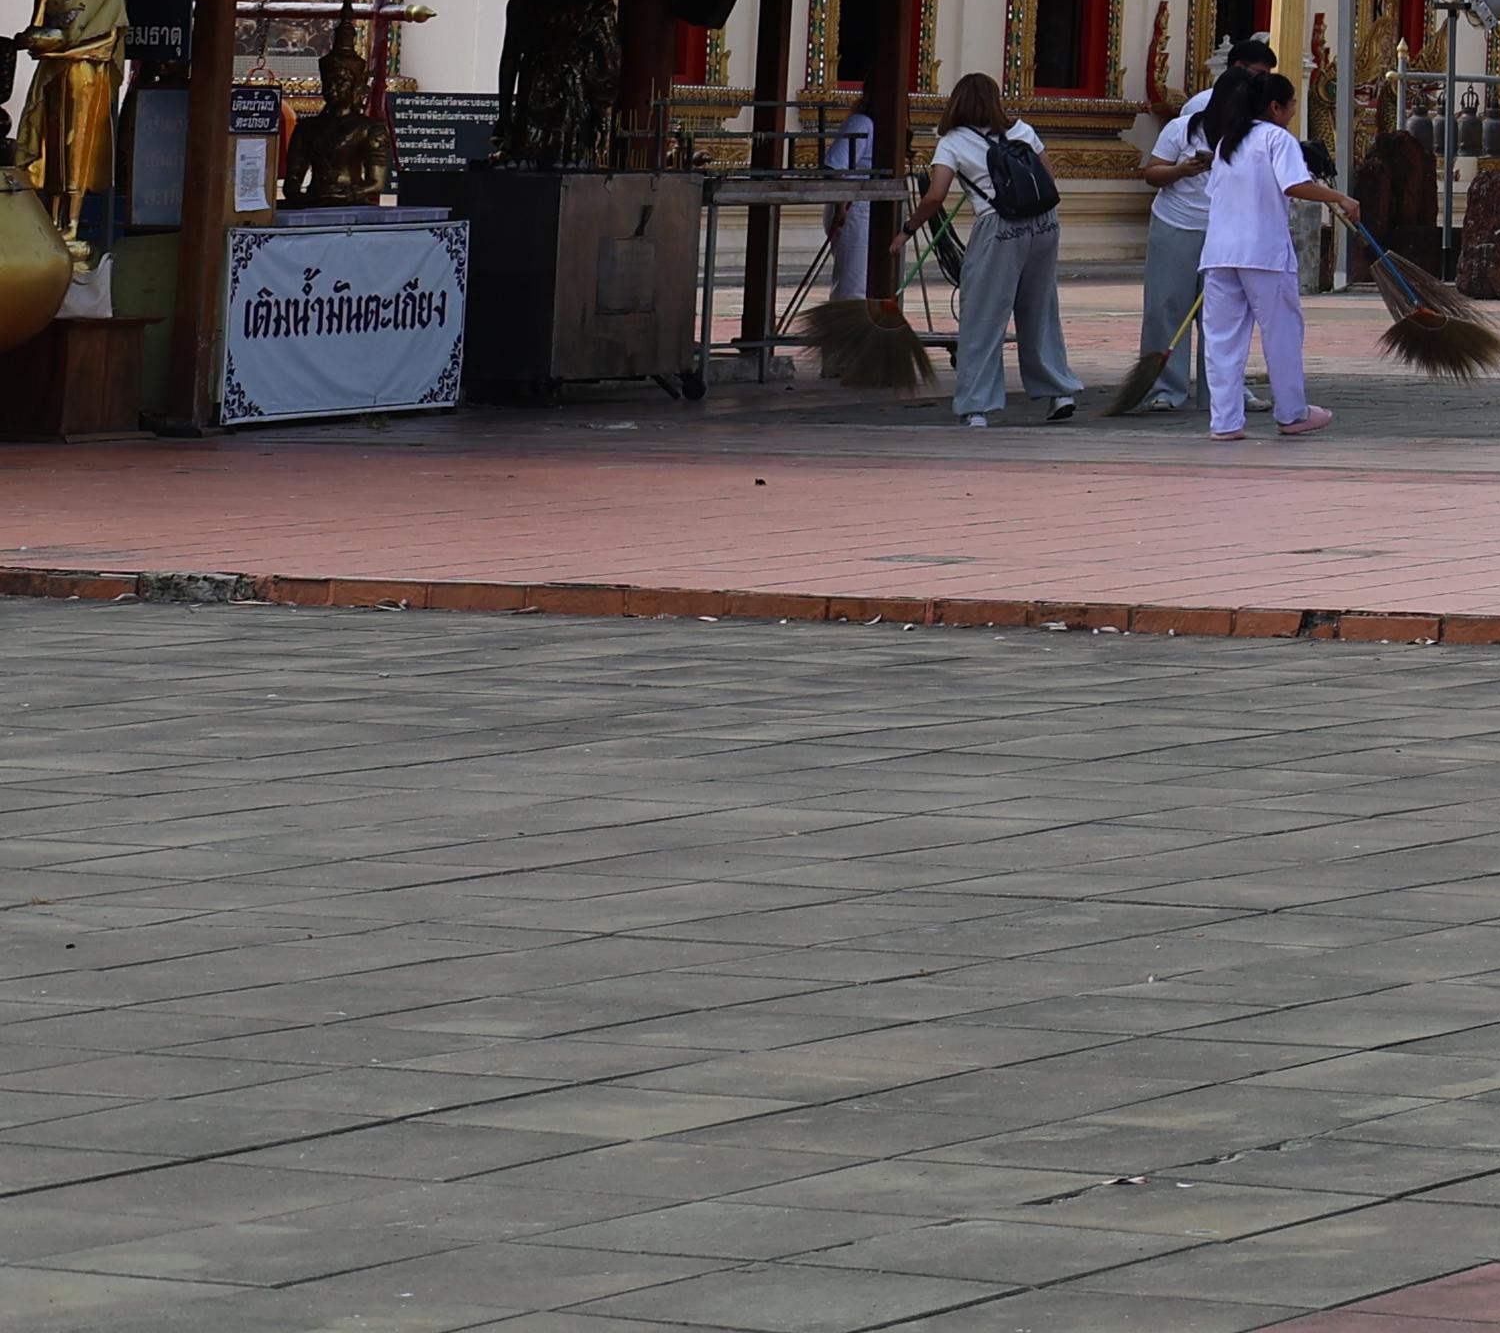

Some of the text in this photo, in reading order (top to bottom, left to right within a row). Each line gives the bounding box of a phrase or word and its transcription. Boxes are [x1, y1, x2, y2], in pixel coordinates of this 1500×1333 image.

[235, 113, 270, 128] ตะเกียง
[244, 267, 447, 339] เติมน้ำมันตะเกียง
